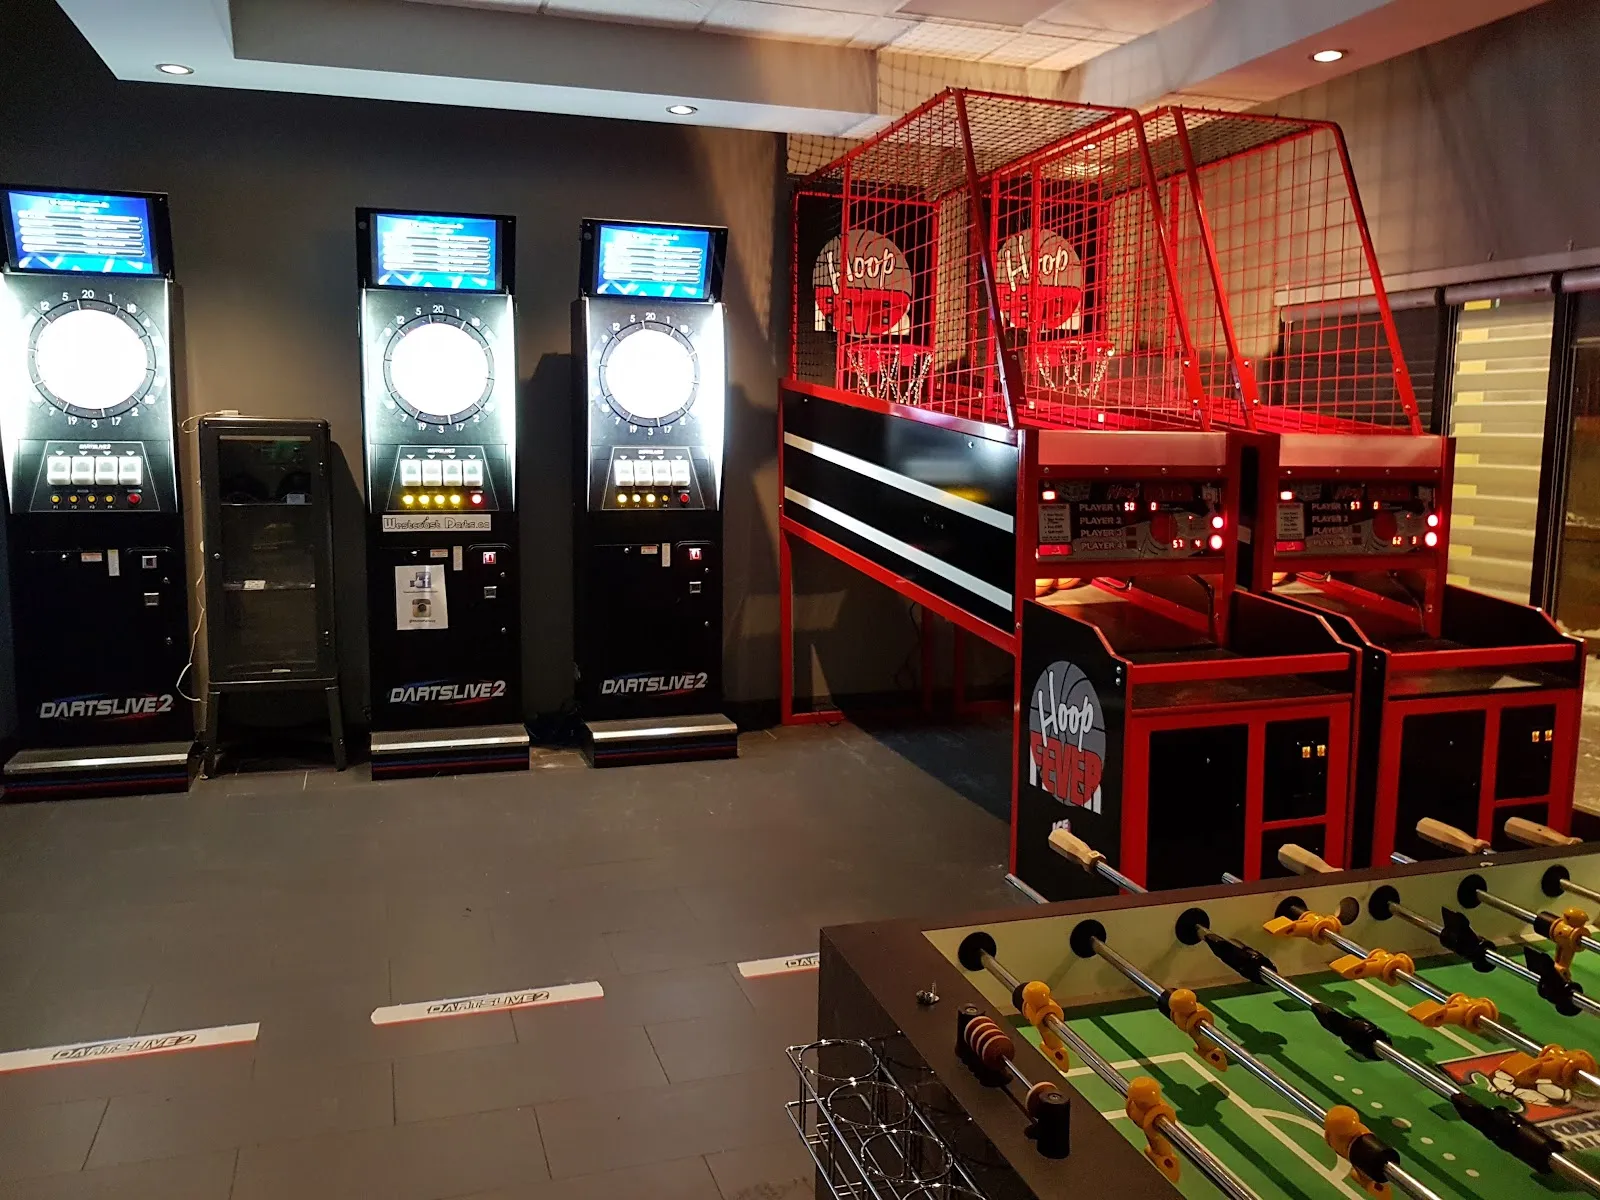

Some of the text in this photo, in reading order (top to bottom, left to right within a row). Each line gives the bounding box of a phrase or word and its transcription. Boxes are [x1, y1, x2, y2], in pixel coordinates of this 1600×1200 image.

[1005, 234, 1068, 291] Hop
[62, 291, 69, 301] 5
[81, 289, 95, 299] 20
[107, 293, 114, 303] 1
[40, 301, 50, 311] 12
[432, 304, 444, 314] 20
[415, 307, 422, 316] 5
[455, 308, 460, 317] 1
[645, 312, 657, 321] 20
[396, 315, 405, 325] 12
[630, 314, 636, 323] 5
[666, 315, 671, 324] 1
[131, 407, 139, 417] 2
[67, 416, 78, 426] 19
[91, 418, 98, 428] 3
[111, 416, 122, 426] 17
[418, 422, 427, 431] 19
[438, 425, 445, 434] 3
[456, 423, 465, 432] 17
[629, 425, 638, 433] 19
[647, 427, 654, 436] 3
[663, 425, 673, 434] 17
[1079, 504, 1114, 512] PLAYER
[1312, 502, 1341, 510] PLAYER
[384, 516, 441, 530] Westcoast
[1079, 516, 1122, 524] PLAYER 2
[1080, 529, 1114, 537] PLAYER
[1082, 542, 1115, 550] PLAYER
[602, 672, 708, 694] DARTSLIVE2
[390, 680, 506, 703] DARTSLIVE2
[40, 694, 174, 718] DARTSLIVE2
[1038, 671, 1093, 752] Hoop
[1029, 731, 1102, 814] FEVER
[51, 1034, 196, 1060] DARTSLIVE2
